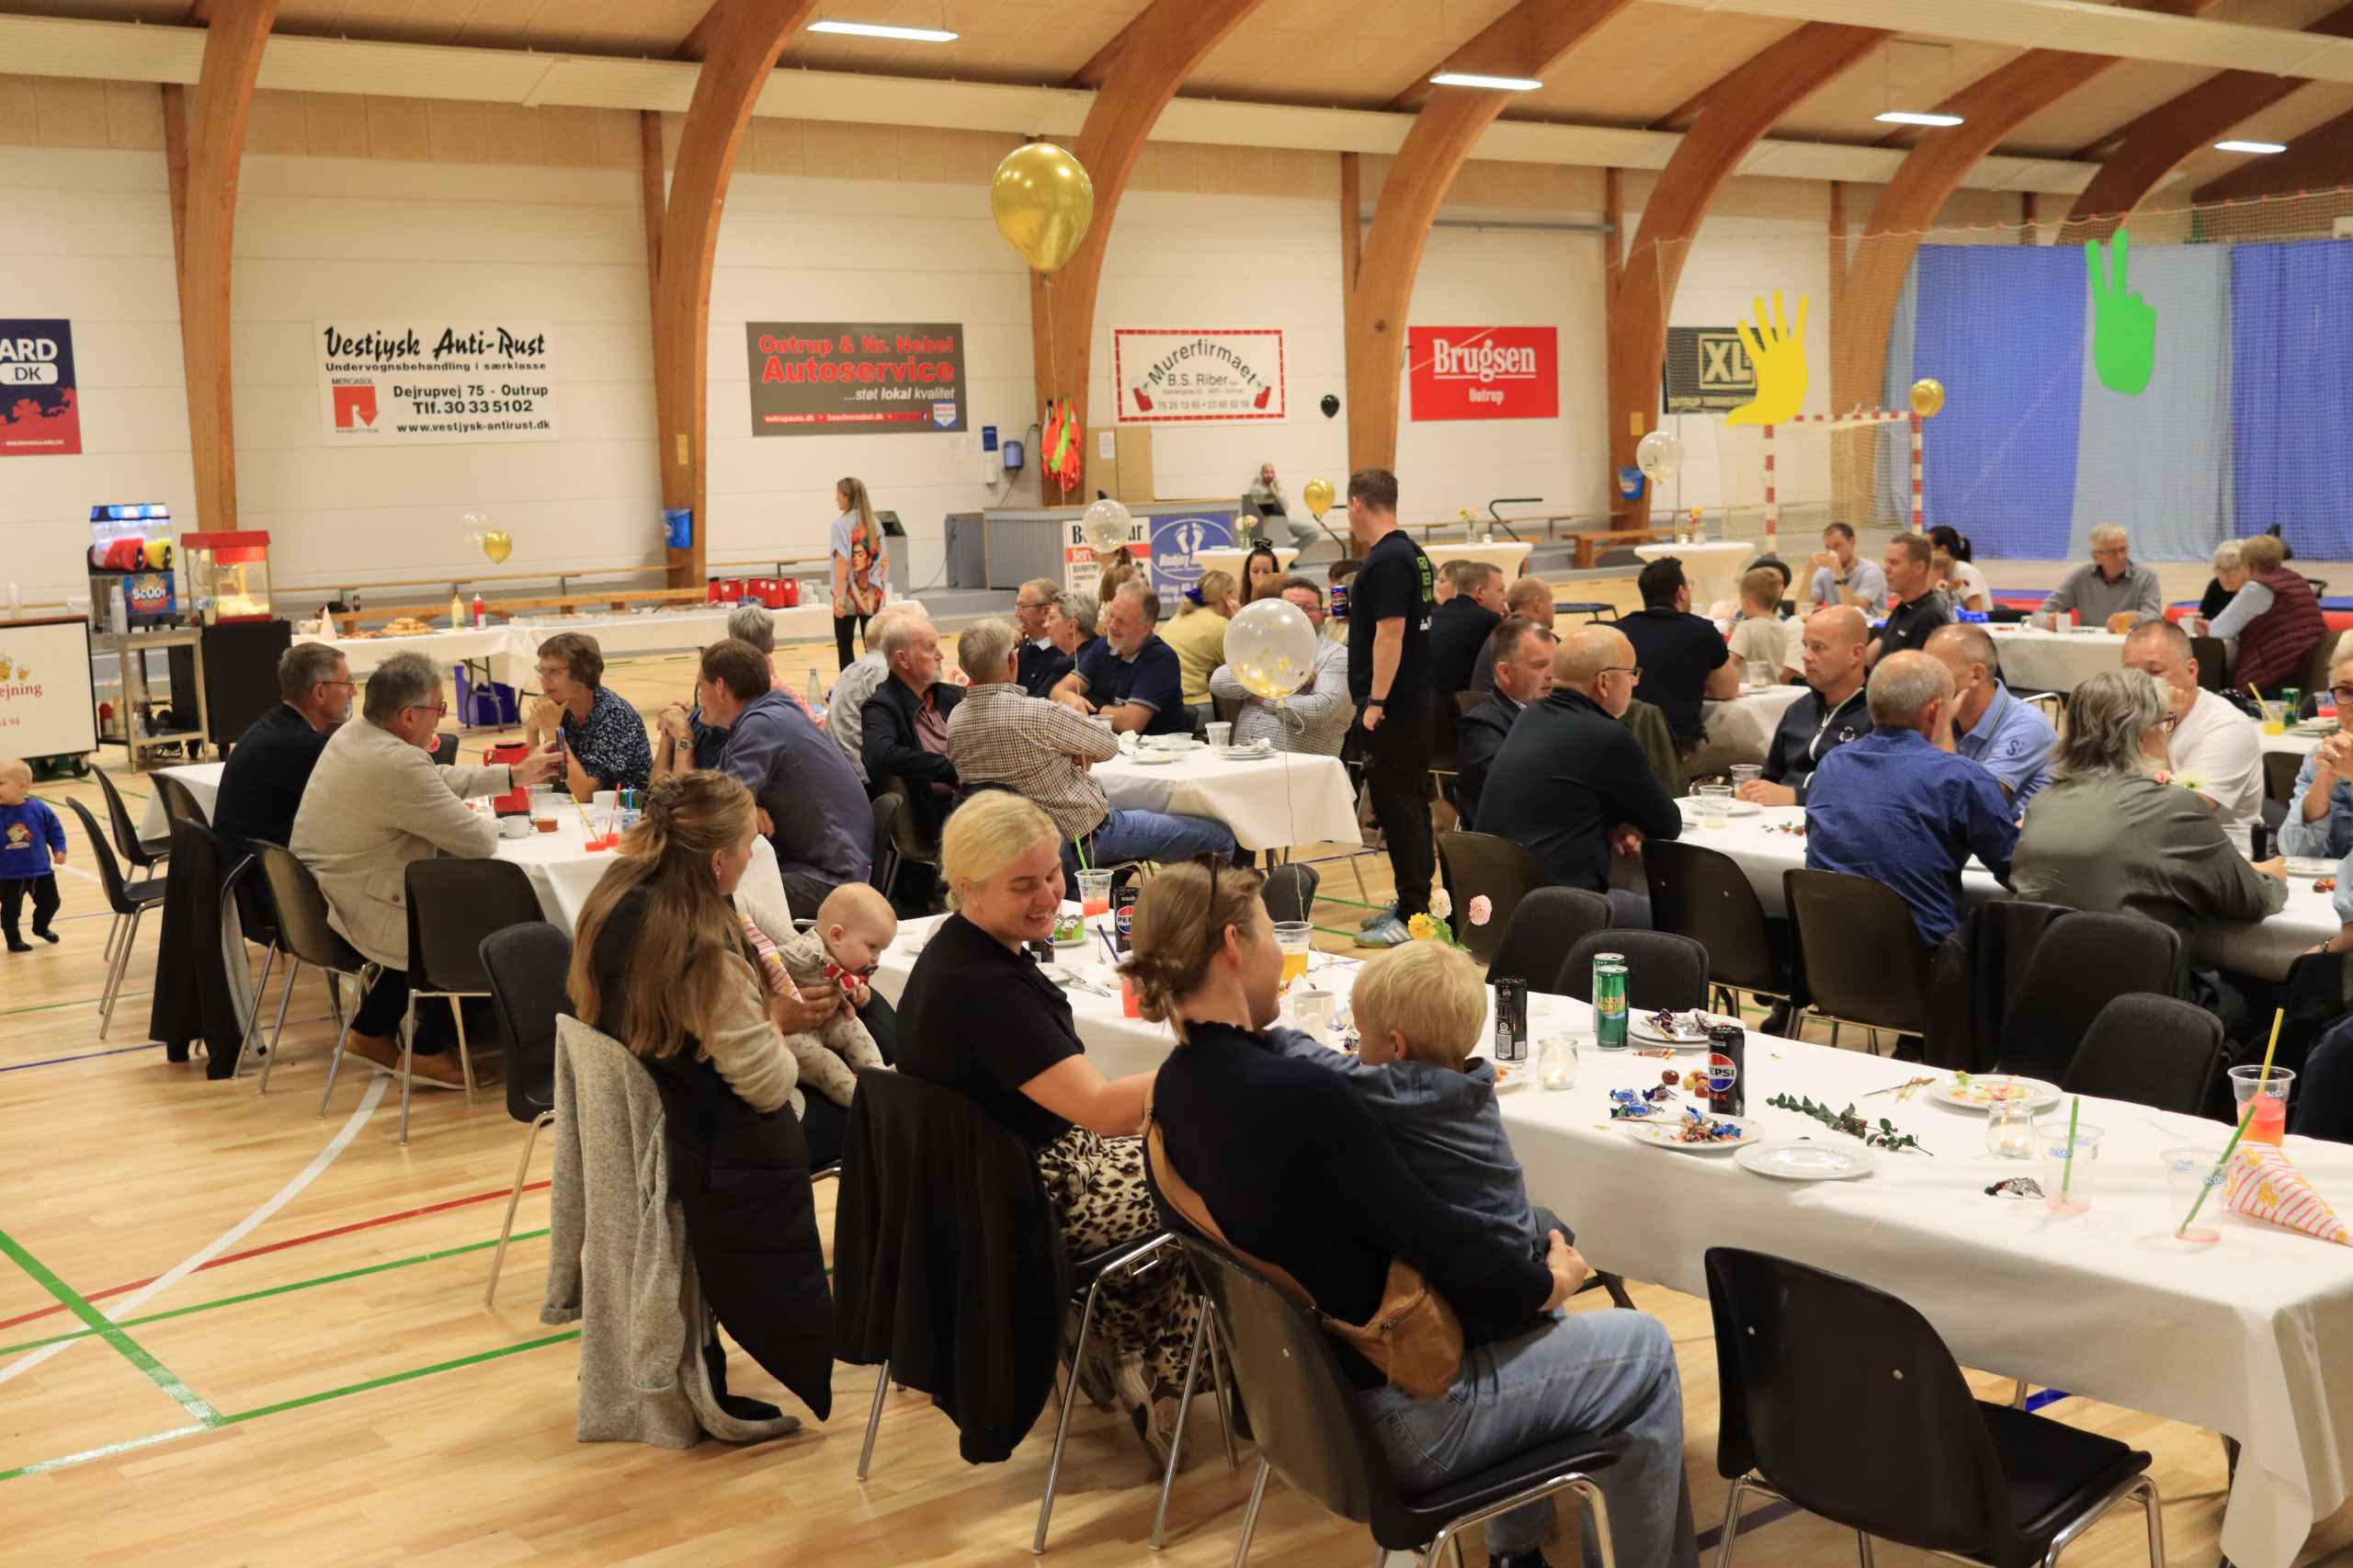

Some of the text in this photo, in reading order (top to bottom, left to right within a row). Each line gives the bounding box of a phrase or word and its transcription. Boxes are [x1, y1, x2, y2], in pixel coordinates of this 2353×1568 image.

[324, 325, 545, 362] Vestjysk Anti-Rust
[759, 335, 833, 357] Outrup
[838, 335, 855, 353] &
[324, 362, 471, 372] Undervognsbehandling
[483, 362, 546, 370] særklasse
[1148, 338, 1257, 386] Murerfirmaet
[1432, 338, 1537, 382] Brugsen
[762, 356, 955, 383] Autoservice
[1167, 372, 1228, 387] B.S. Riber
[393, 385, 461, 399] Dejrupvej
[468, 384, 484, 396] 75
[501, 383, 549, 397] Outrup
[881, 386, 912, 401] lokal
[914, 386, 955, 400] kvalitet
[1468, 387, 1505, 405] Outrup
[413, 402, 441, 415] Tlf.
[397, 420, 551, 434] www.vestjysk-antirust.dk
[1709, 1067, 1734, 1077] EPSI
